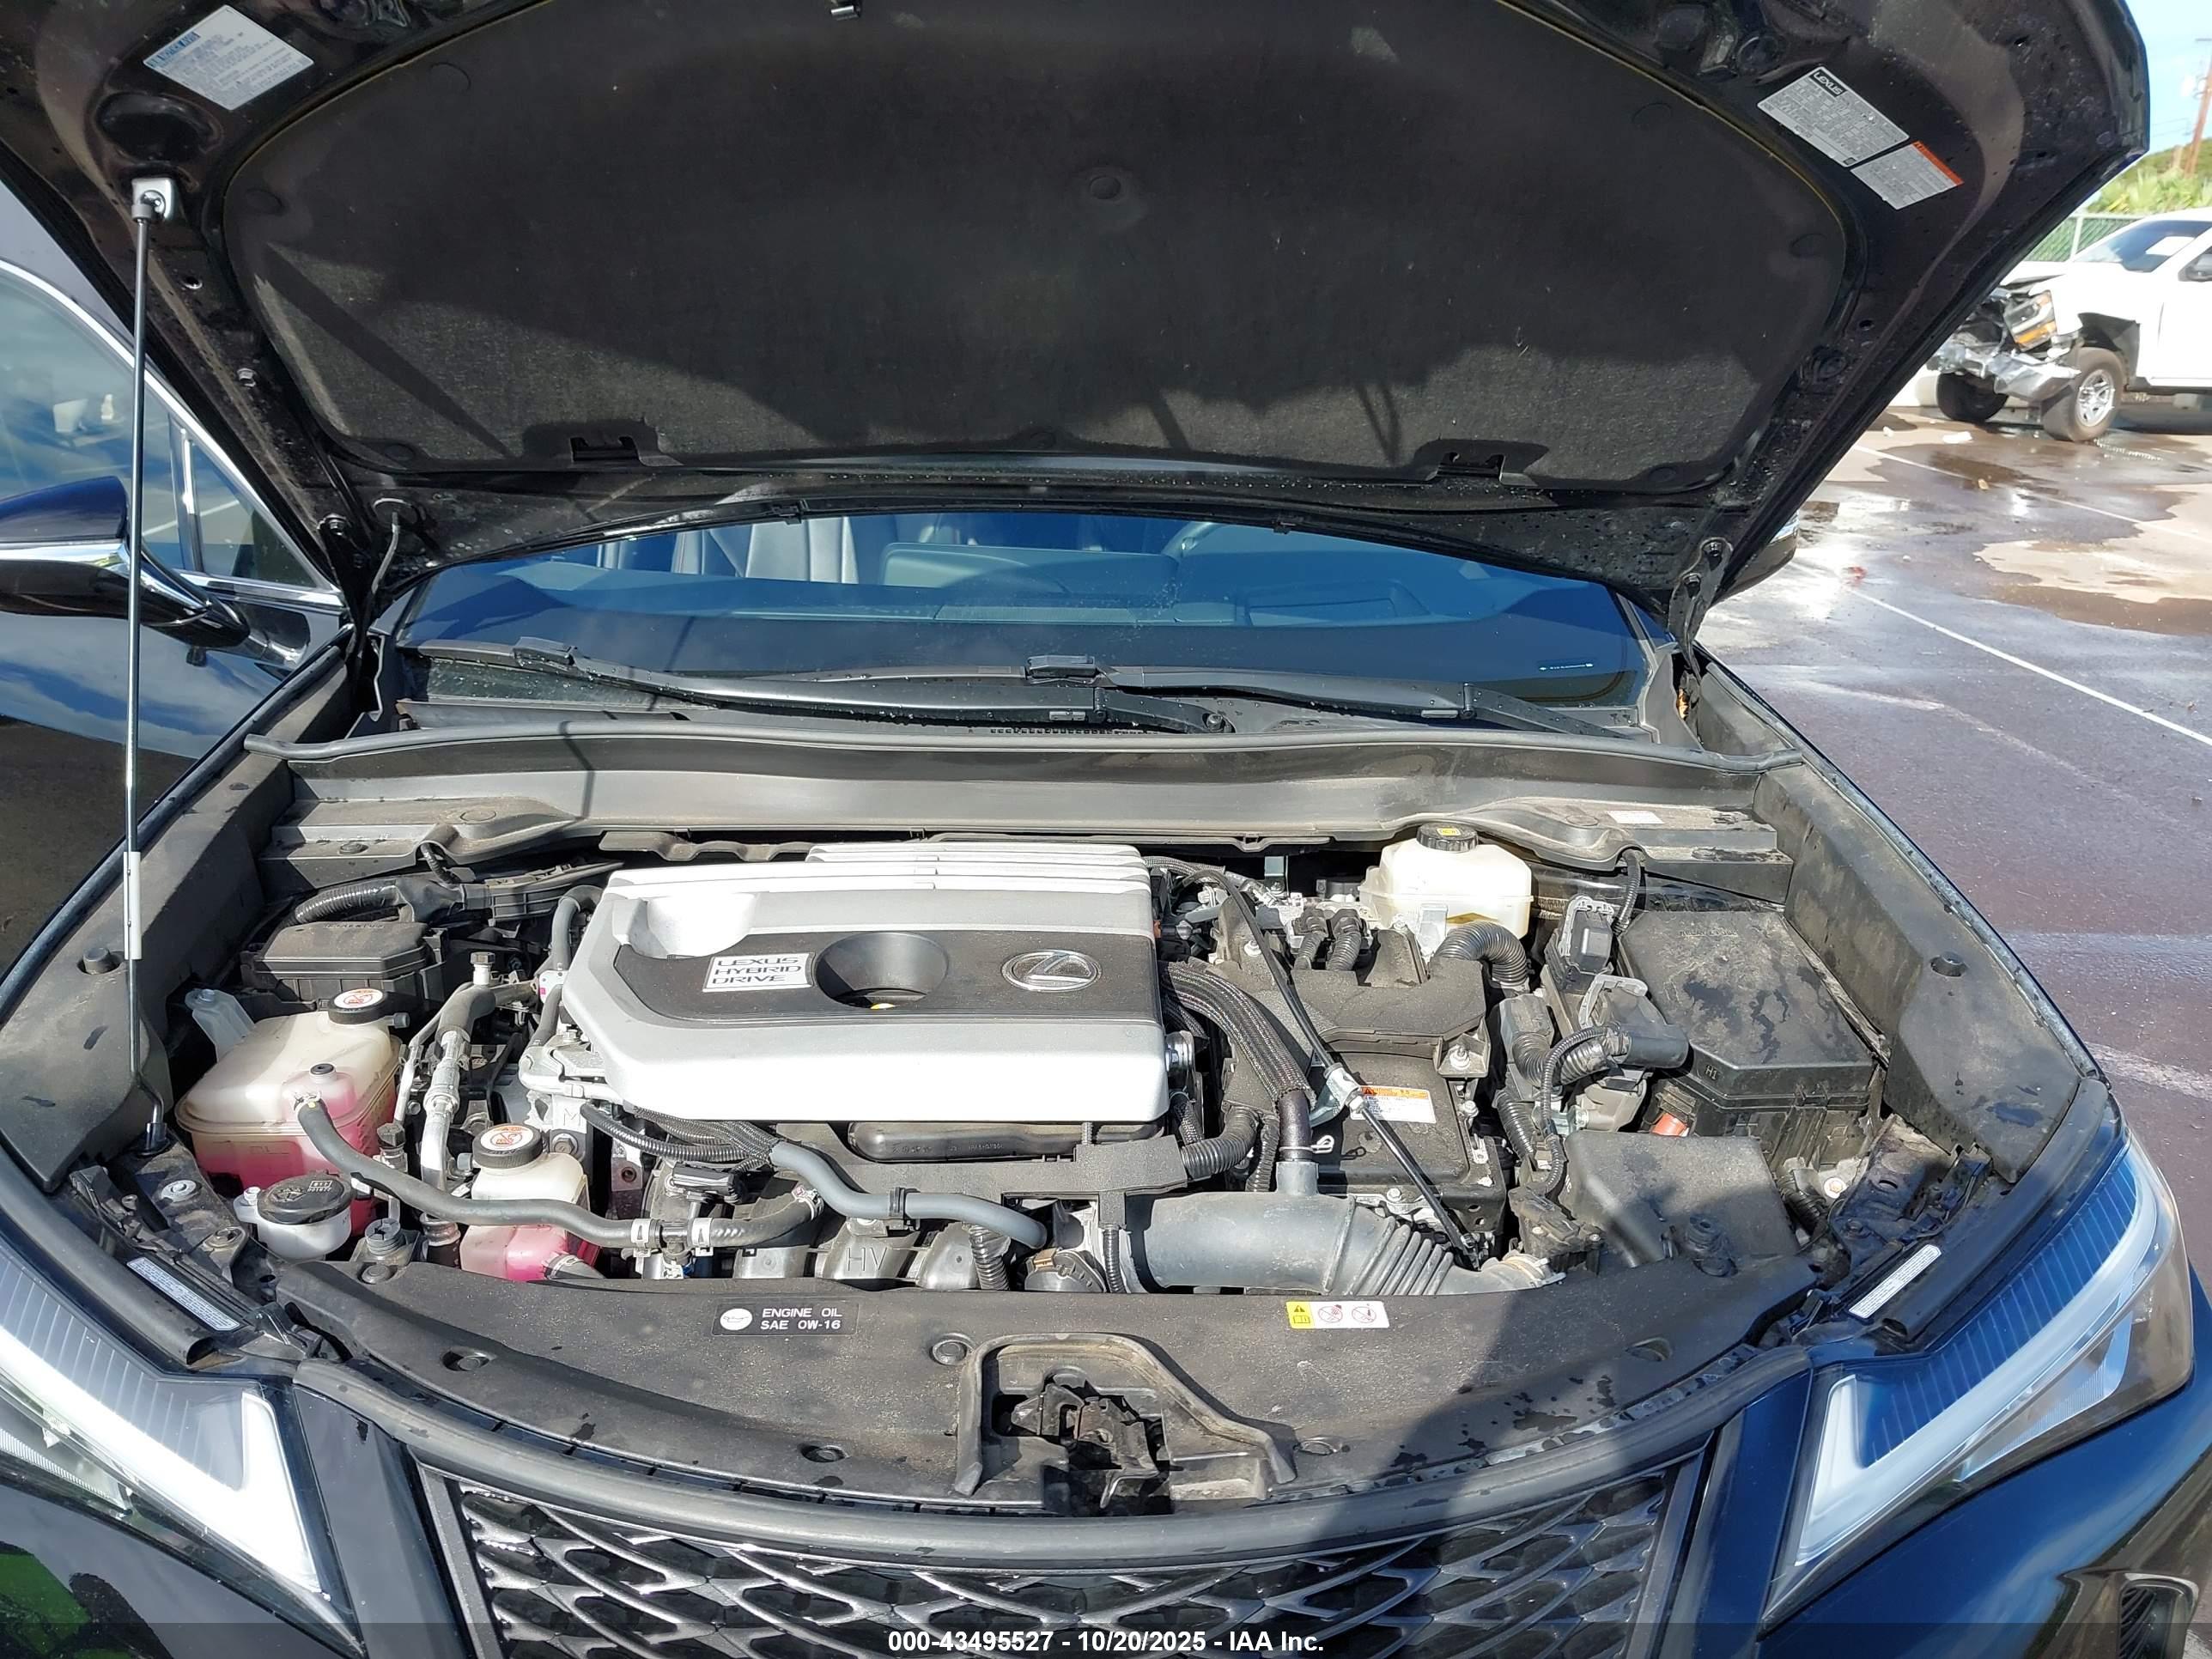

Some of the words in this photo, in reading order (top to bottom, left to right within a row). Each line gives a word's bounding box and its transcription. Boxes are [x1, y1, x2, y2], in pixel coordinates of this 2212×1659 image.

[717, 957, 799, 966] LEXUS
[714, 966, 802, 975] HYBRID
[712, 975, 787, 984] DRIVE
[847, 1247, 888, 1272] HV
[763, 1308, 813, 1318] ENGINE
[821, 1308, 843, 1318] OIL
[760, 1320, 790, 1330] SAE
